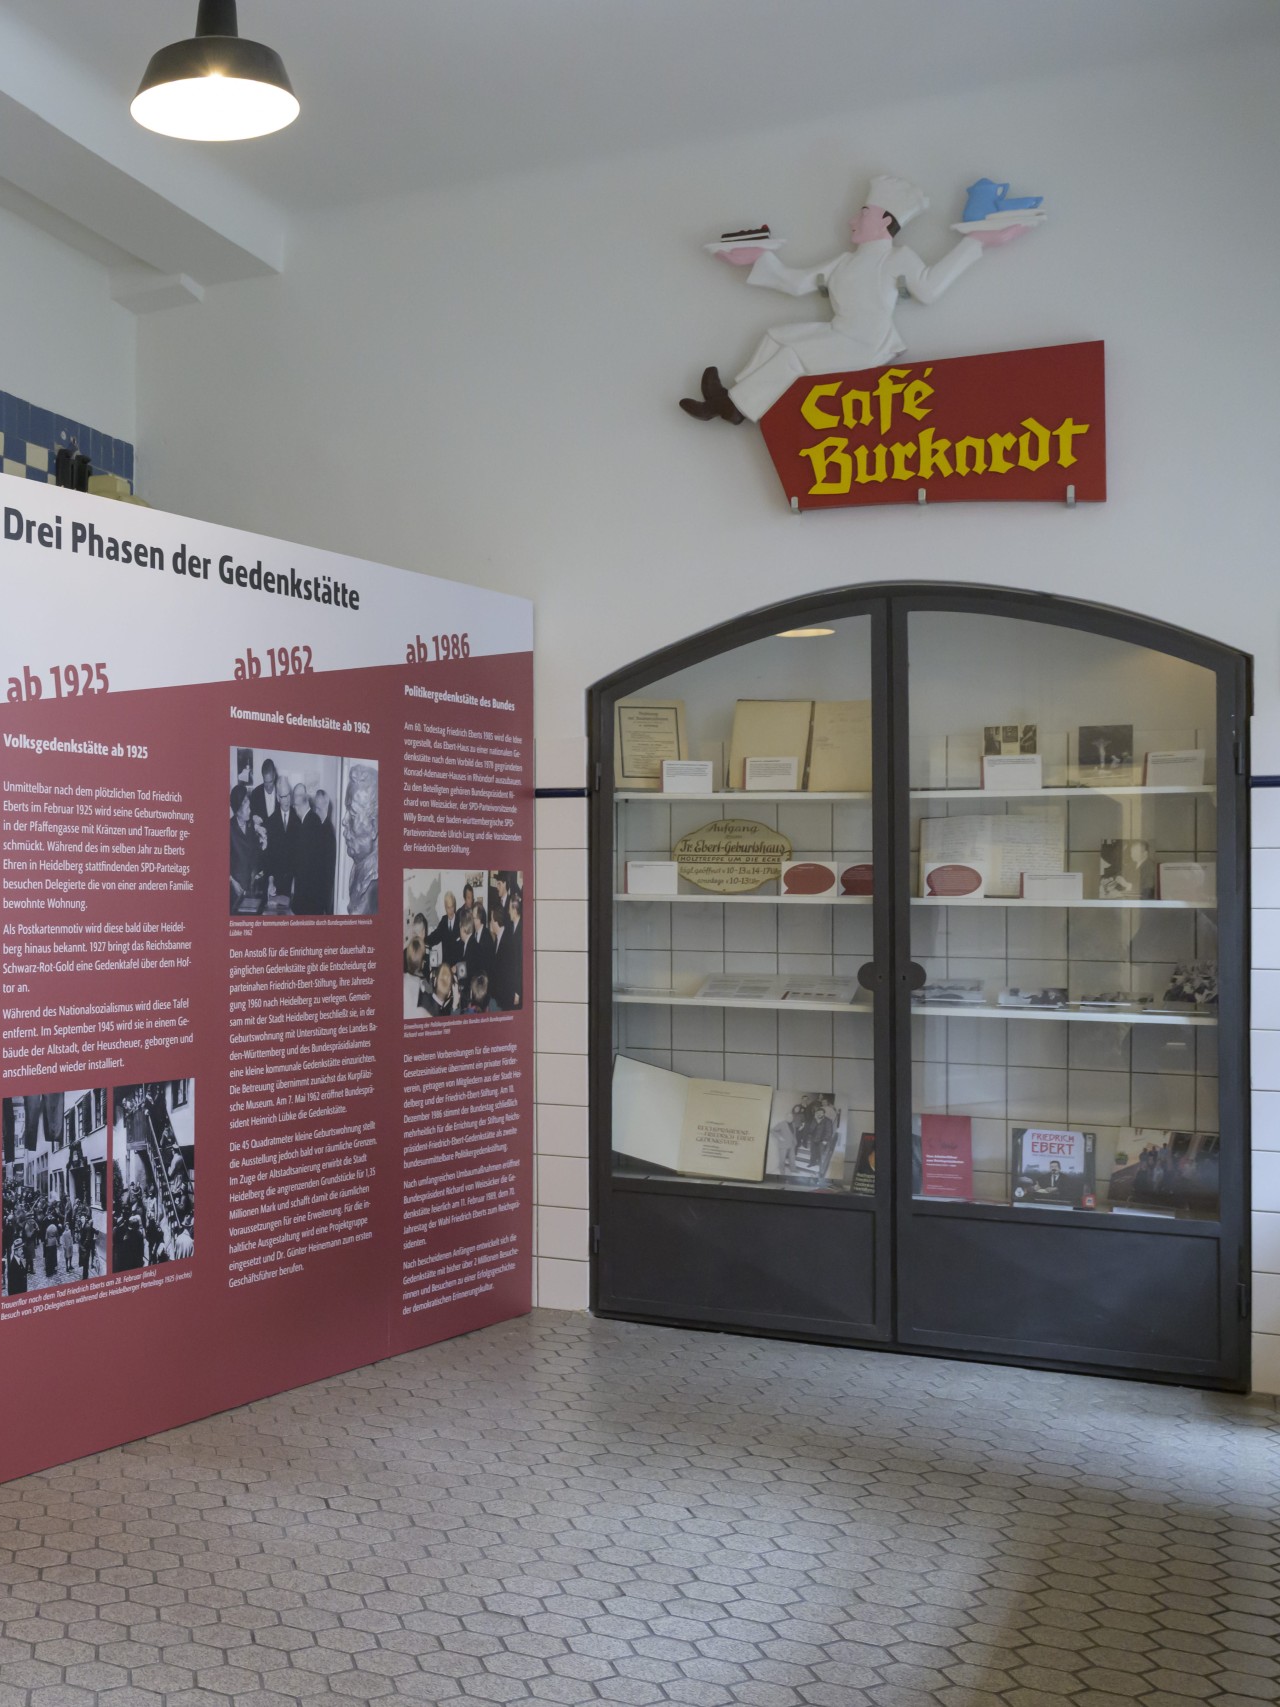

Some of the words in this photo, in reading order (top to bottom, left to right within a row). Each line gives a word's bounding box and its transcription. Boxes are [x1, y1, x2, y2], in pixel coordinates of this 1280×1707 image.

[801, 367, 935, 435] Café
[799, 417, 1090, 495] Burkardt
[3, 507, 63, 550] Drei
[71, 521, 164, 571] Phasen
[172, 543, 211, 580] der
[218, 554, 360, 611] Gedenkstätte
[406, 639, 428, 665] ab
[433, 633, 471, 662] 1986
[233, 648, 261, 681] ab
[267, 645, 314, 677] 1962
[6, 665, 42, 703] ab
[50, 662, 110, 698] 1925
[404, 684, 479, 706] Politikergedenkstätte
[479, 695, 491, 707] des
[492, 698, 515, 711] Bundes
[230, 705, 284, 724] Kommunale
[285, 713, 341, 730] Gedenkstätte
[342, 719, 352, 732] ab
[353, 721, 370, 734] 1962
[2, 733, 109, 756] Volksgedenkstätte
[110, 742, 124, 757] ab
[126, 744, 148, 759] 1925
[3, 780, 52, 794] Unmittelbar
[53, 784, 74, 795] nach
[74, 784, 93, 797] dem
[94, 786, 135, 800] plötzlichen
[136, 789, 151, 801] Tod
[152, 790, 182, 802] Friedrich
[3, 799, 29, 812] Eberts
[30, 804, 42, 813] im
[43, 802, 74, 814] Februar
[75, 804, 93, 815] 1925
[94, 805, 112, 817] wird
[113, 806, 133, 818] seine
[133, 807, 194, 823] Geburtswohnung
[2, 858, 27, 870] Ehren
[29, 861, 37, 870] in
[39, 859, 83, 875] Heidelberg
[84, 860, 139, 872] stattfindenden
[140, 861, 190, 876] SPD-Parteitags
[2, 877, 43, 890] besuchen
[44, 878, 86, 893] Delegierte
[87, 878, 100, 890] die
[101, 882, 116, 890] von
[117, 879, 137, 890] einer
[138, 879, 168, 890] anderen
[169, 880, 194, 891] Familie
[2, 923, 16, 935] Als
[17, 922, 83, 935] Postkartenmotiv
[84, 922, 102, 933] wird
[103, 922, 124, 933] diese
[124, 921, 141, 933] bald
[142, 921, 159, 933] über
[160, 921, 186, 932] Heidel-
[1031, 1132, 1075, 1143] FRIEDRICH
[1031, 1141, 1075, 1155] EBERT
